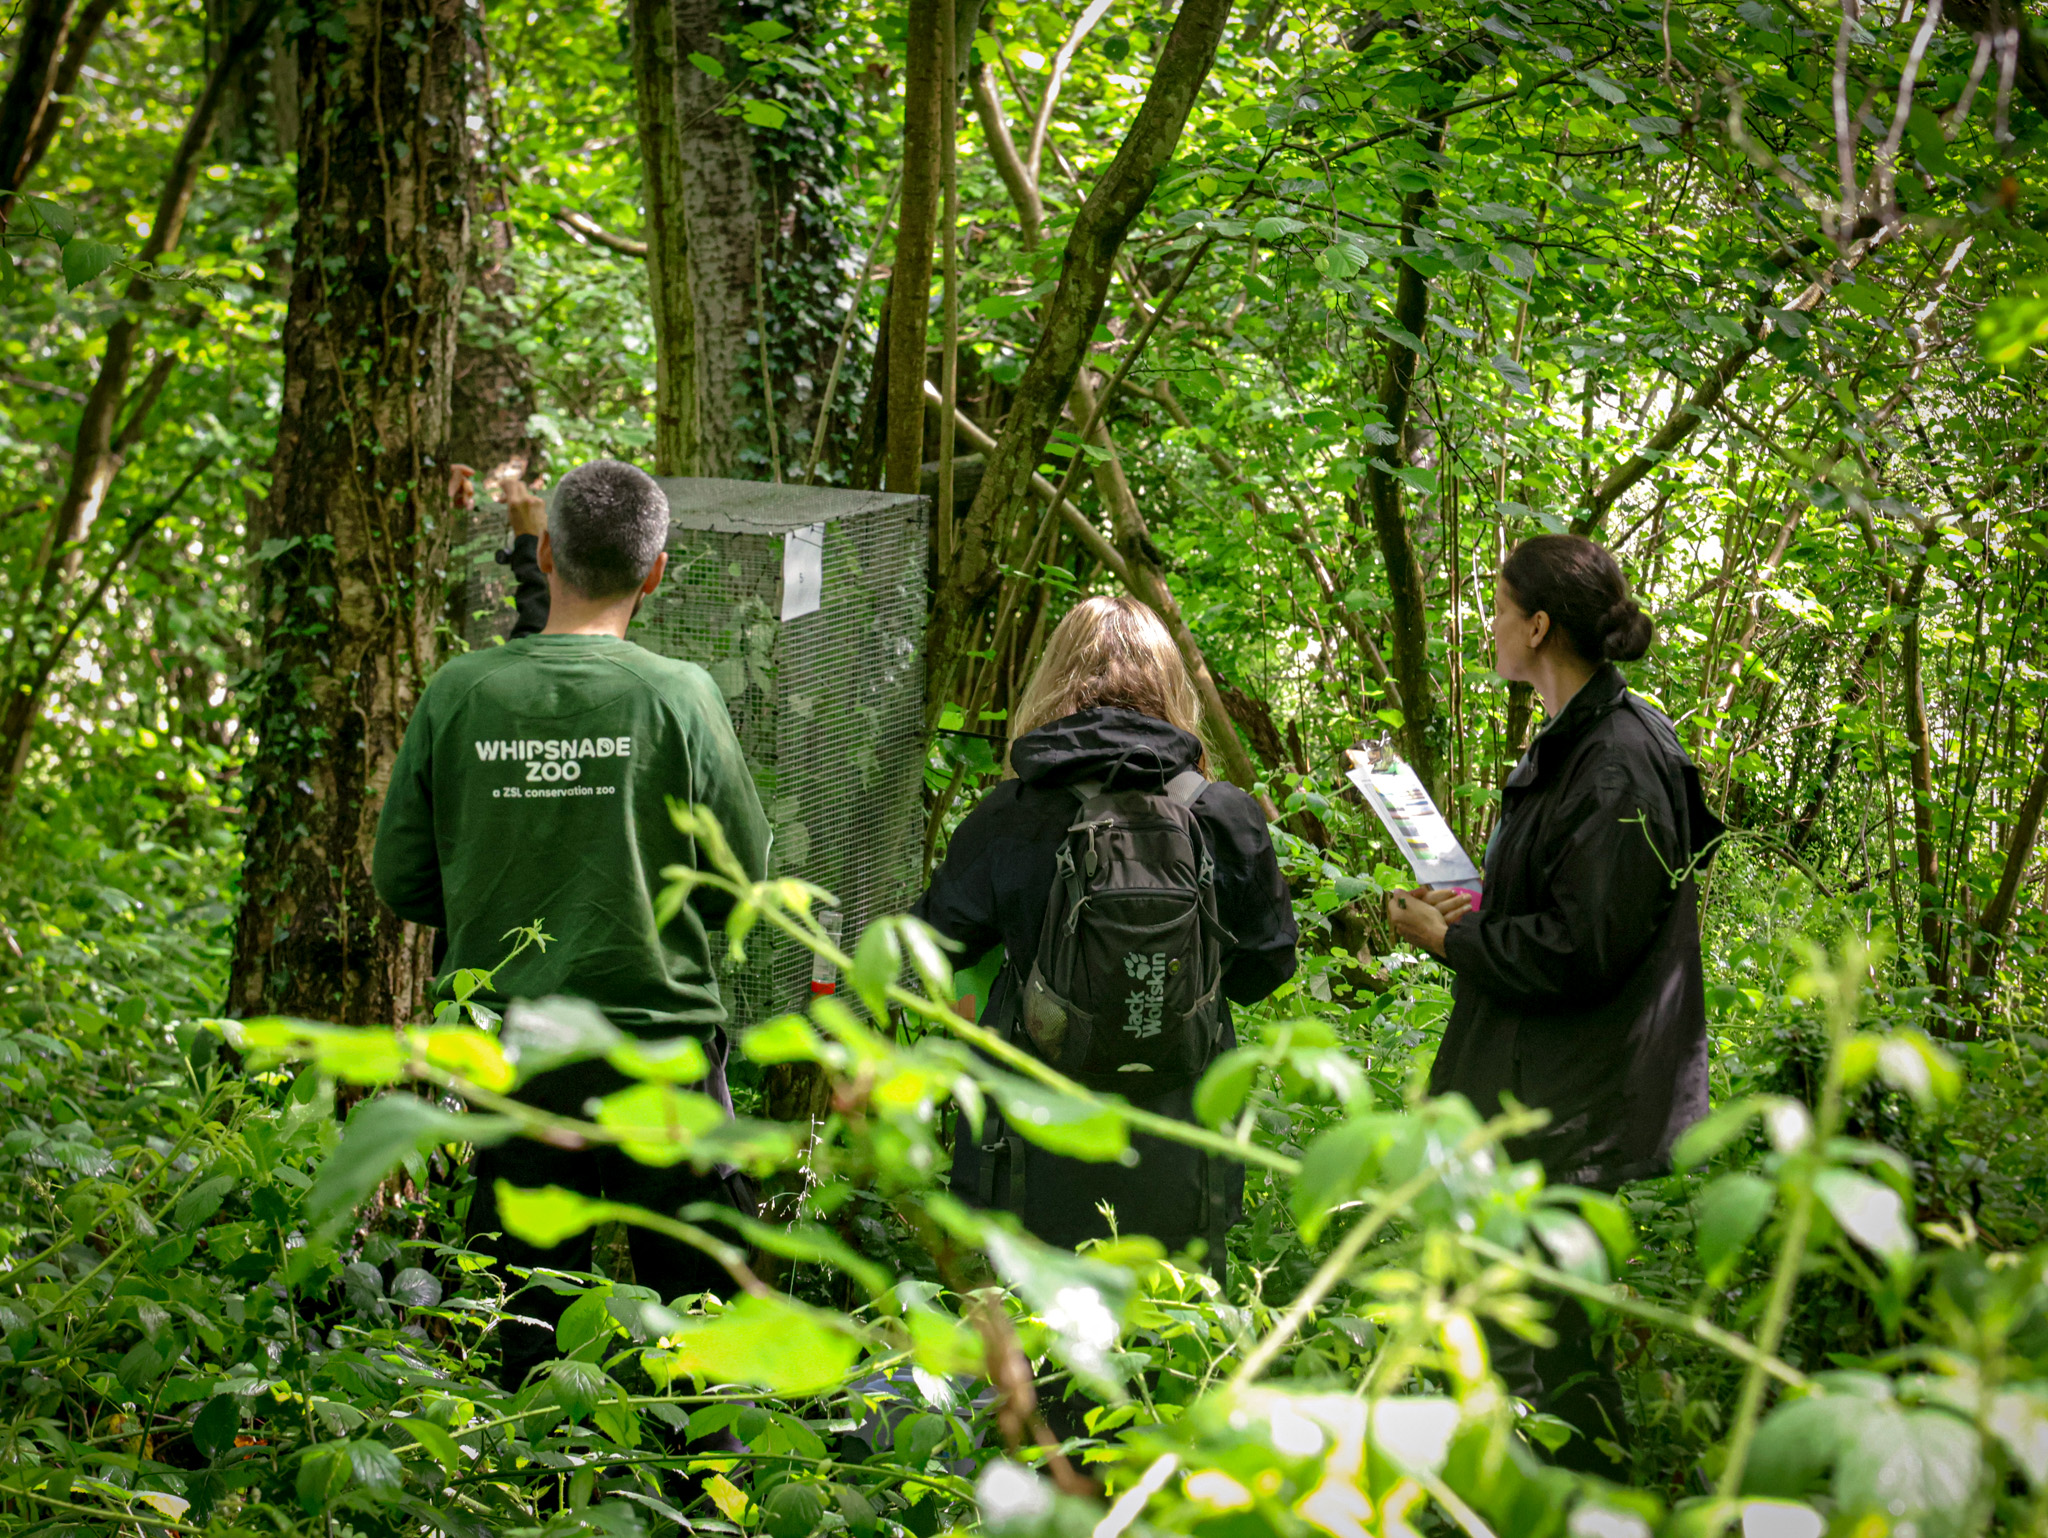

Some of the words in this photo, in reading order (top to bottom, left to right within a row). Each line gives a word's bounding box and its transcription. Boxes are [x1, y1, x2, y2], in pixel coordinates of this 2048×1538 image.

[475, 736, 631, 761] WHIPSNADE
[525, 760, 581, 782] ZOO
[492, 788, 501, 798] a
[503, 787, 523, 798] ZSL
[524, 785, 594, 798] conservation
[596, 785, 616, 795] zoo
[1142, 952, 1166, 1038] Wolfskin
[1122, 989, 1145, 1038] Jack
